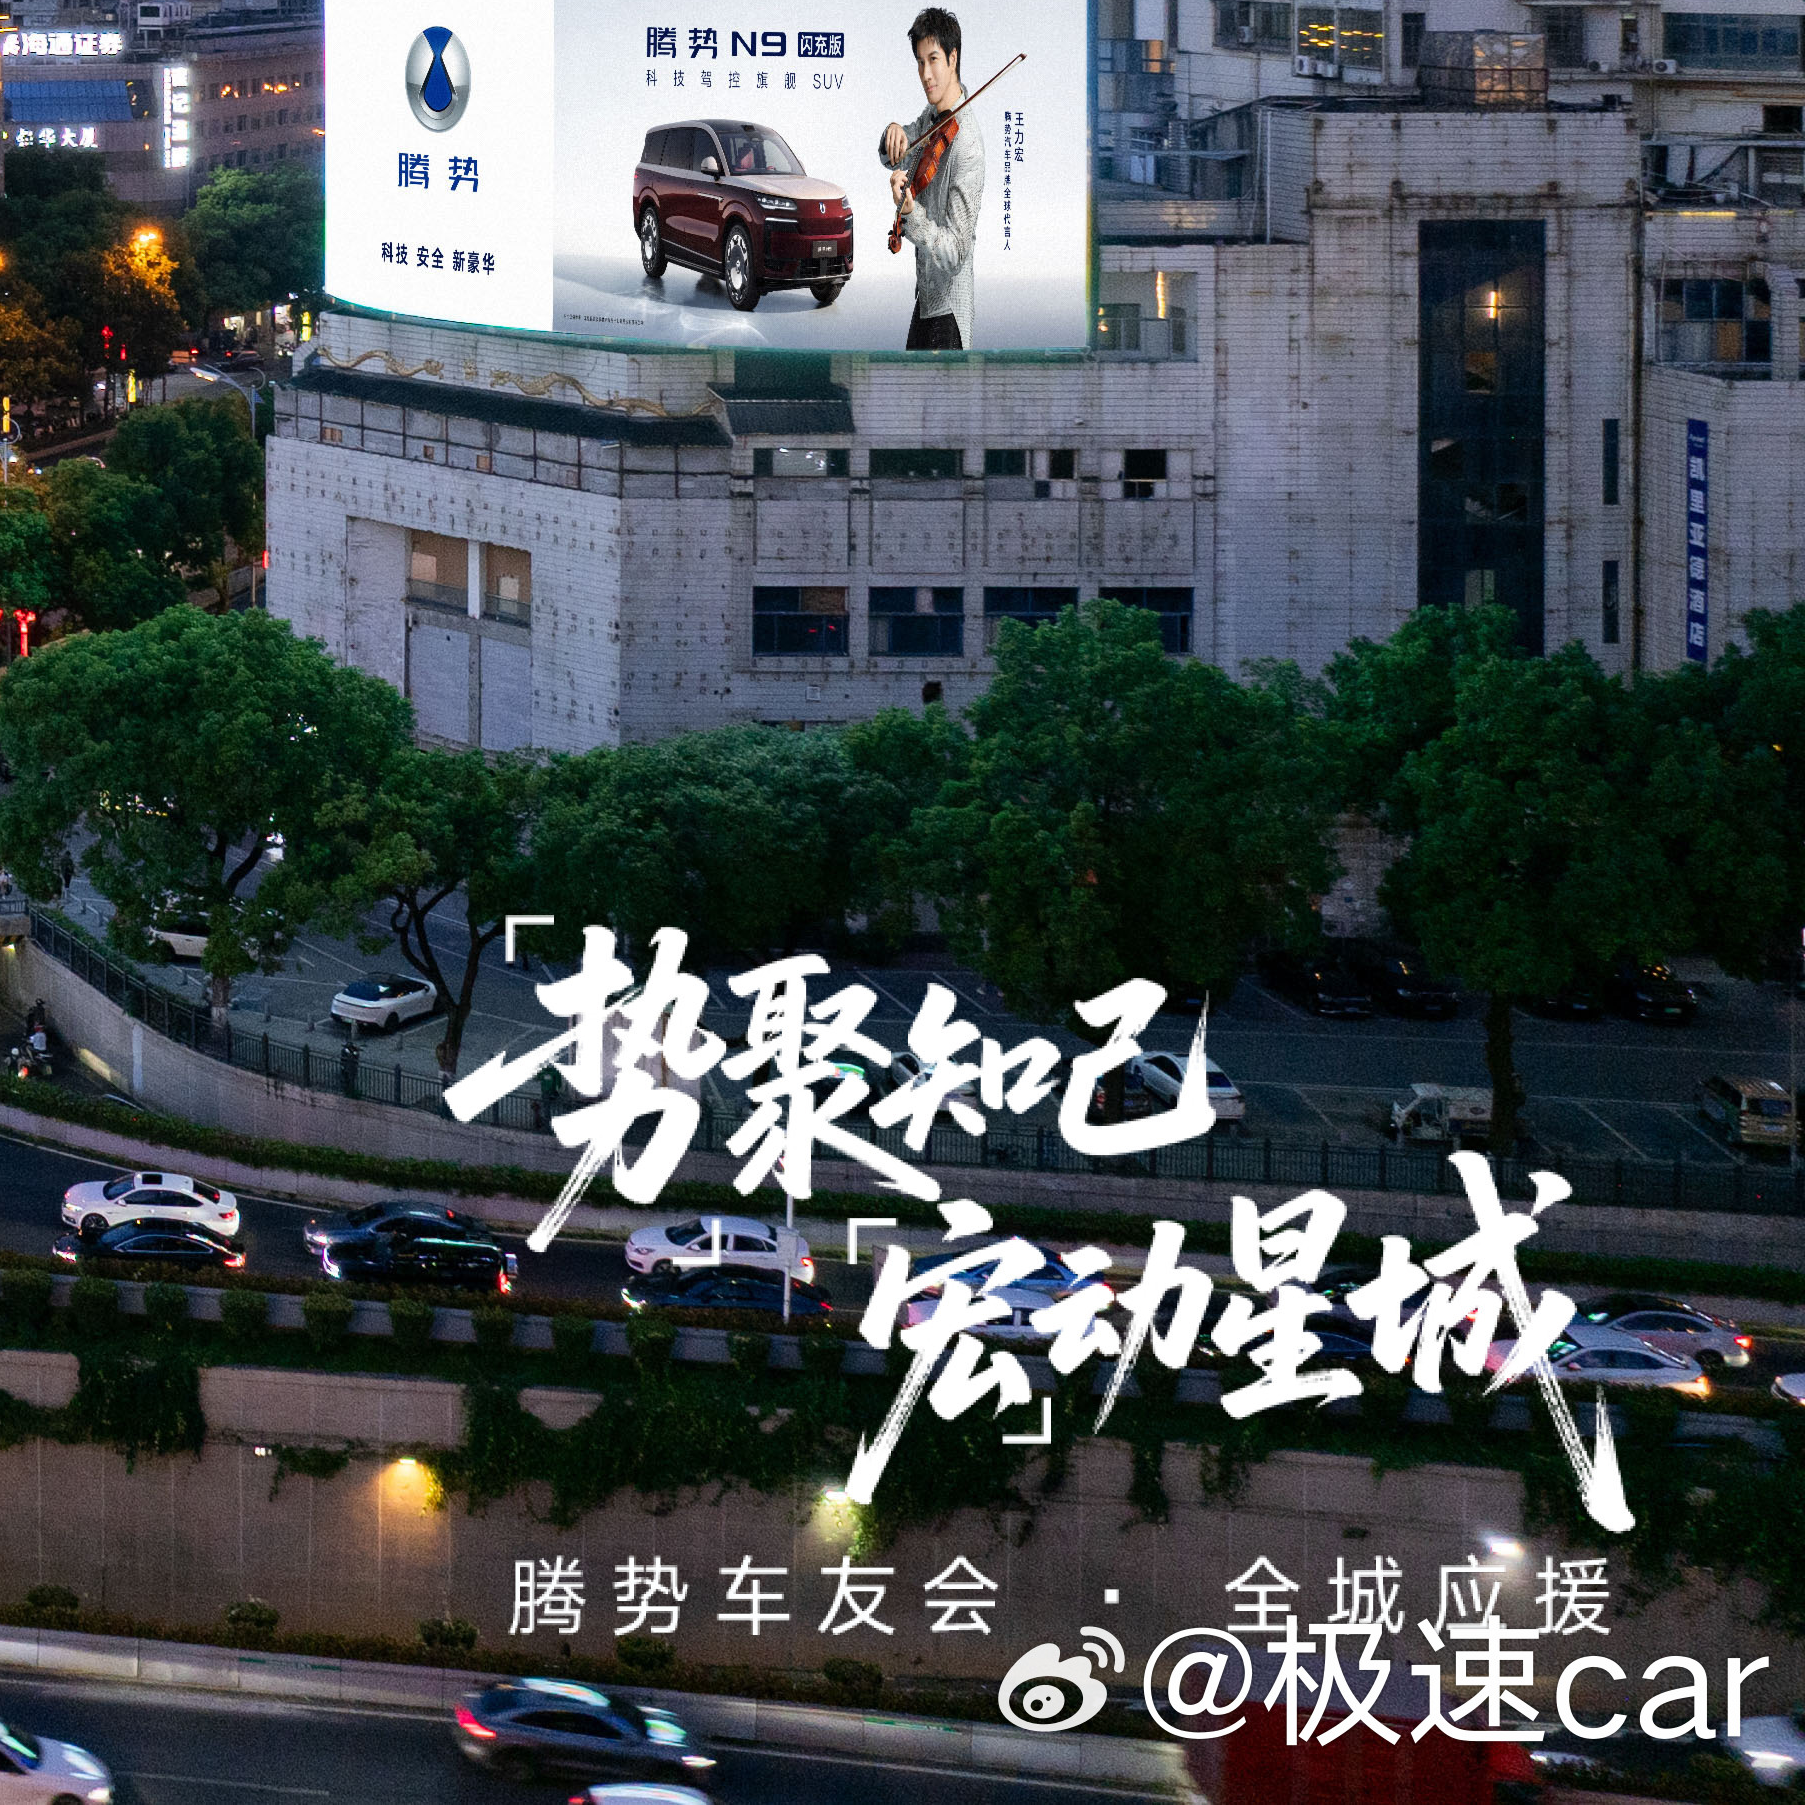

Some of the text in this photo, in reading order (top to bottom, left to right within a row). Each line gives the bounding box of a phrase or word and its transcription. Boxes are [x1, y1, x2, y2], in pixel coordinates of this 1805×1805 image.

[646, 26, 843, 59] 腾势 N9 闪充版
[646, 69, 844, 90] 科技驾控旗舰 SUV
[1014, 111, 1024, 164] 王力宏
[397, 151, 480, 193] 腾势
[381, 240, 495, 276] 科技 安全 新豪华
